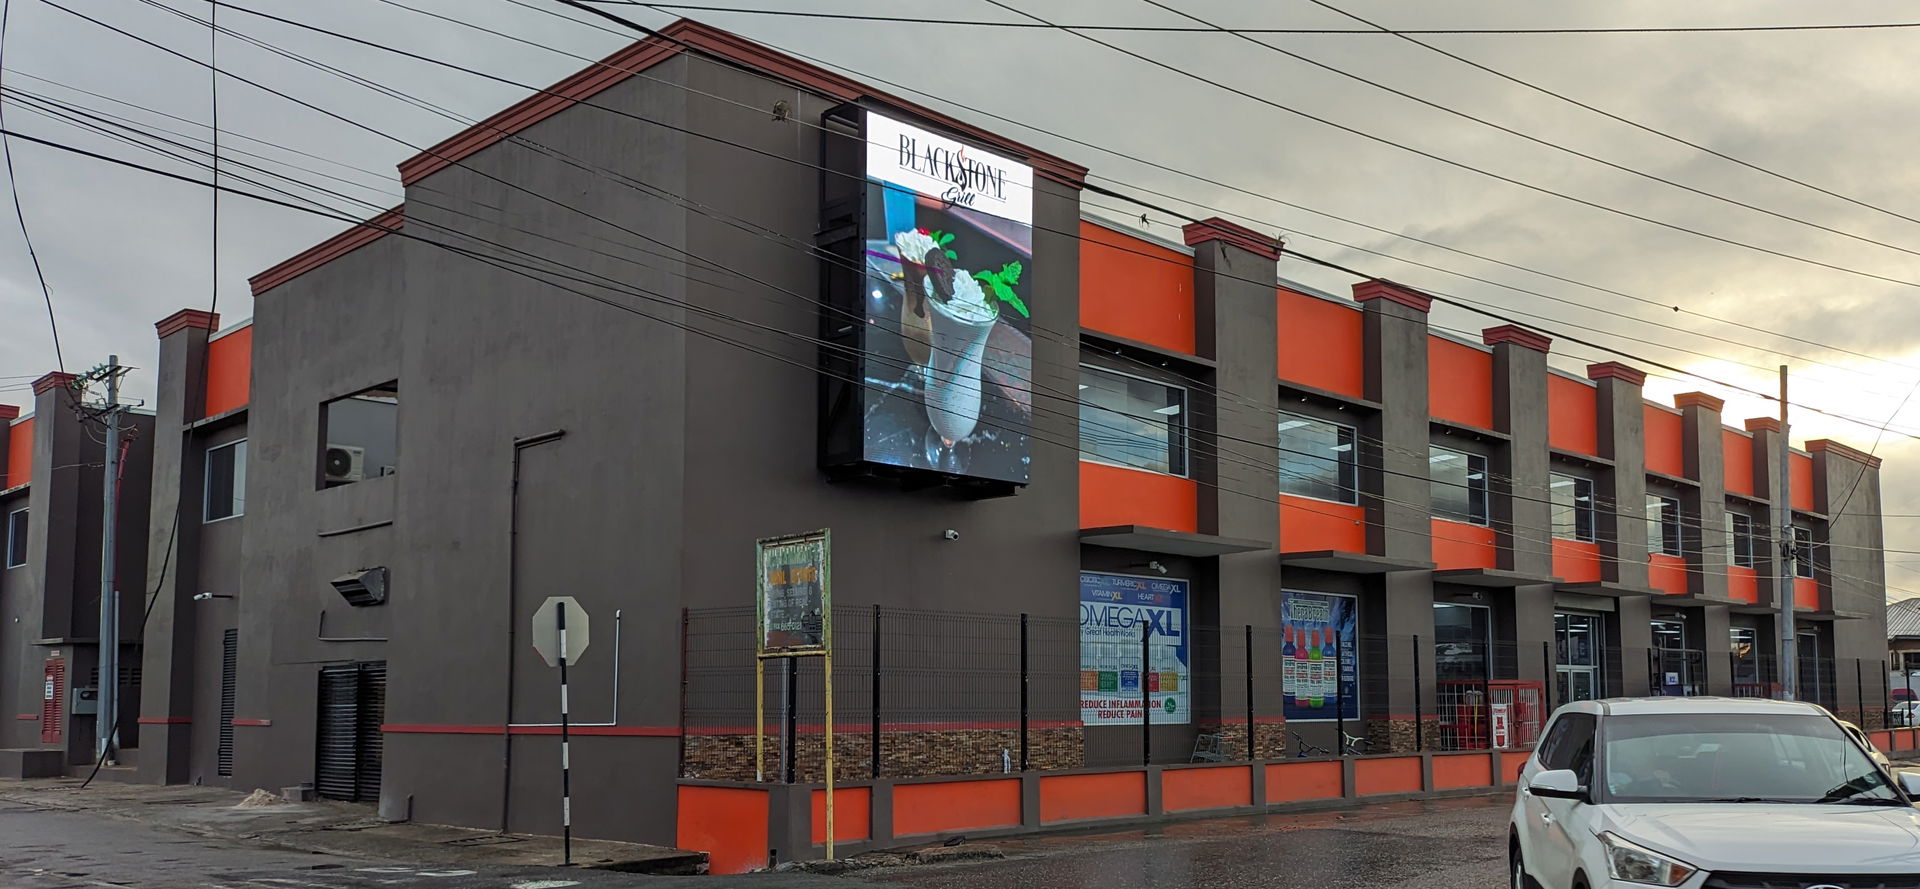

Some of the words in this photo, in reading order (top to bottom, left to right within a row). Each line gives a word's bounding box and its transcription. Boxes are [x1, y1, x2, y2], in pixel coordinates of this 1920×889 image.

[899, 133, 1007, 200] BLACKSTONE
[941, 186, 977, 209] Grill
[1080, 699, 1107, 709] REDUCE
[1109, 699, 1162, 709] INFLAMMION
[1097, 710, 1125, 719] REDUCE
[1126, 709, 1143, 719] PAIN
